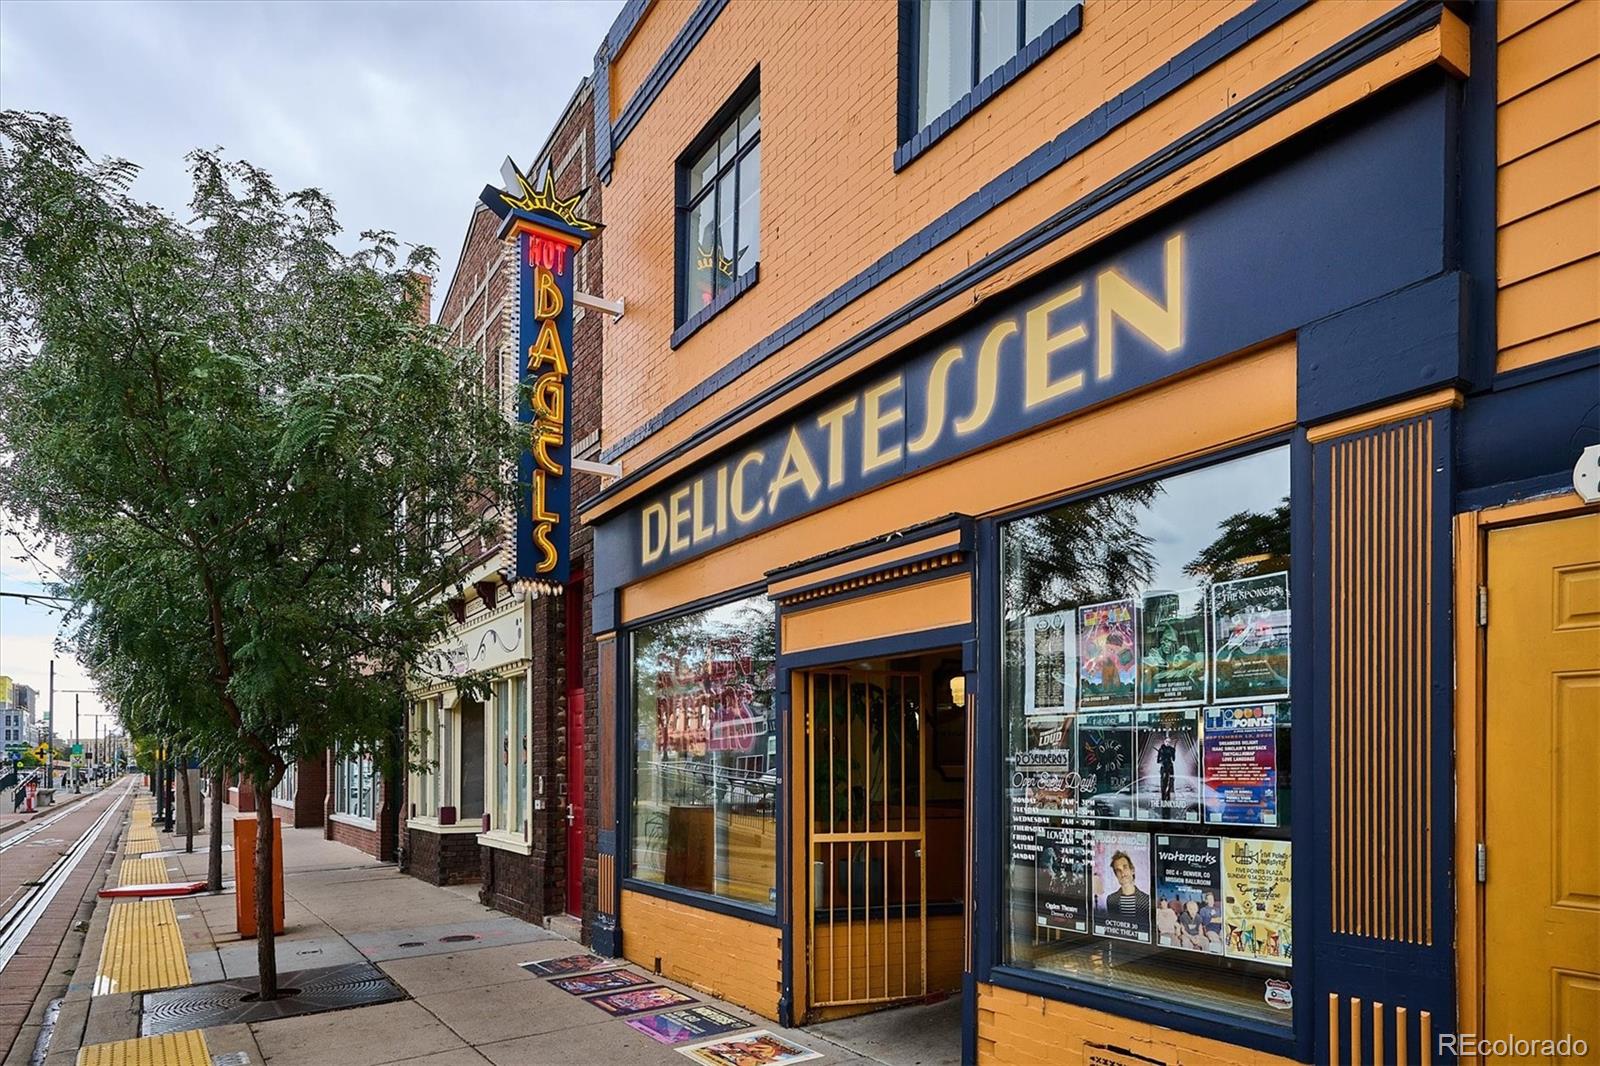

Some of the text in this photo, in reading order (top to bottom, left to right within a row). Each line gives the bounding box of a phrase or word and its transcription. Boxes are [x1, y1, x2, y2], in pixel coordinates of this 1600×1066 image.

[529, 234, 567, 276] HOT
[641, 233, 1184, 567] DELICATESSEN
[527, 266, 569, 574] BAGELS
[1232, 716, 1274, 728] POINTS
[1038, 731, 1063, 747] LOUD
[1012, 772, 1037, 791] Open
[1012, 815, 1050, 823] WEDNESDAY
[1012, 825, 1045, 833] THURSDAY
[1012, 833, 1034, 842] FRIDAY
[1012, 843, 1044, 852] SATURDAY
[1012, 852, 1035, 861] SUNDAY
[1158, 850, 1217, 865] waterparks
[1184, 878, 1211, 887] BALLROOM
[1105, 919, 1131, 928] OCTOBER
